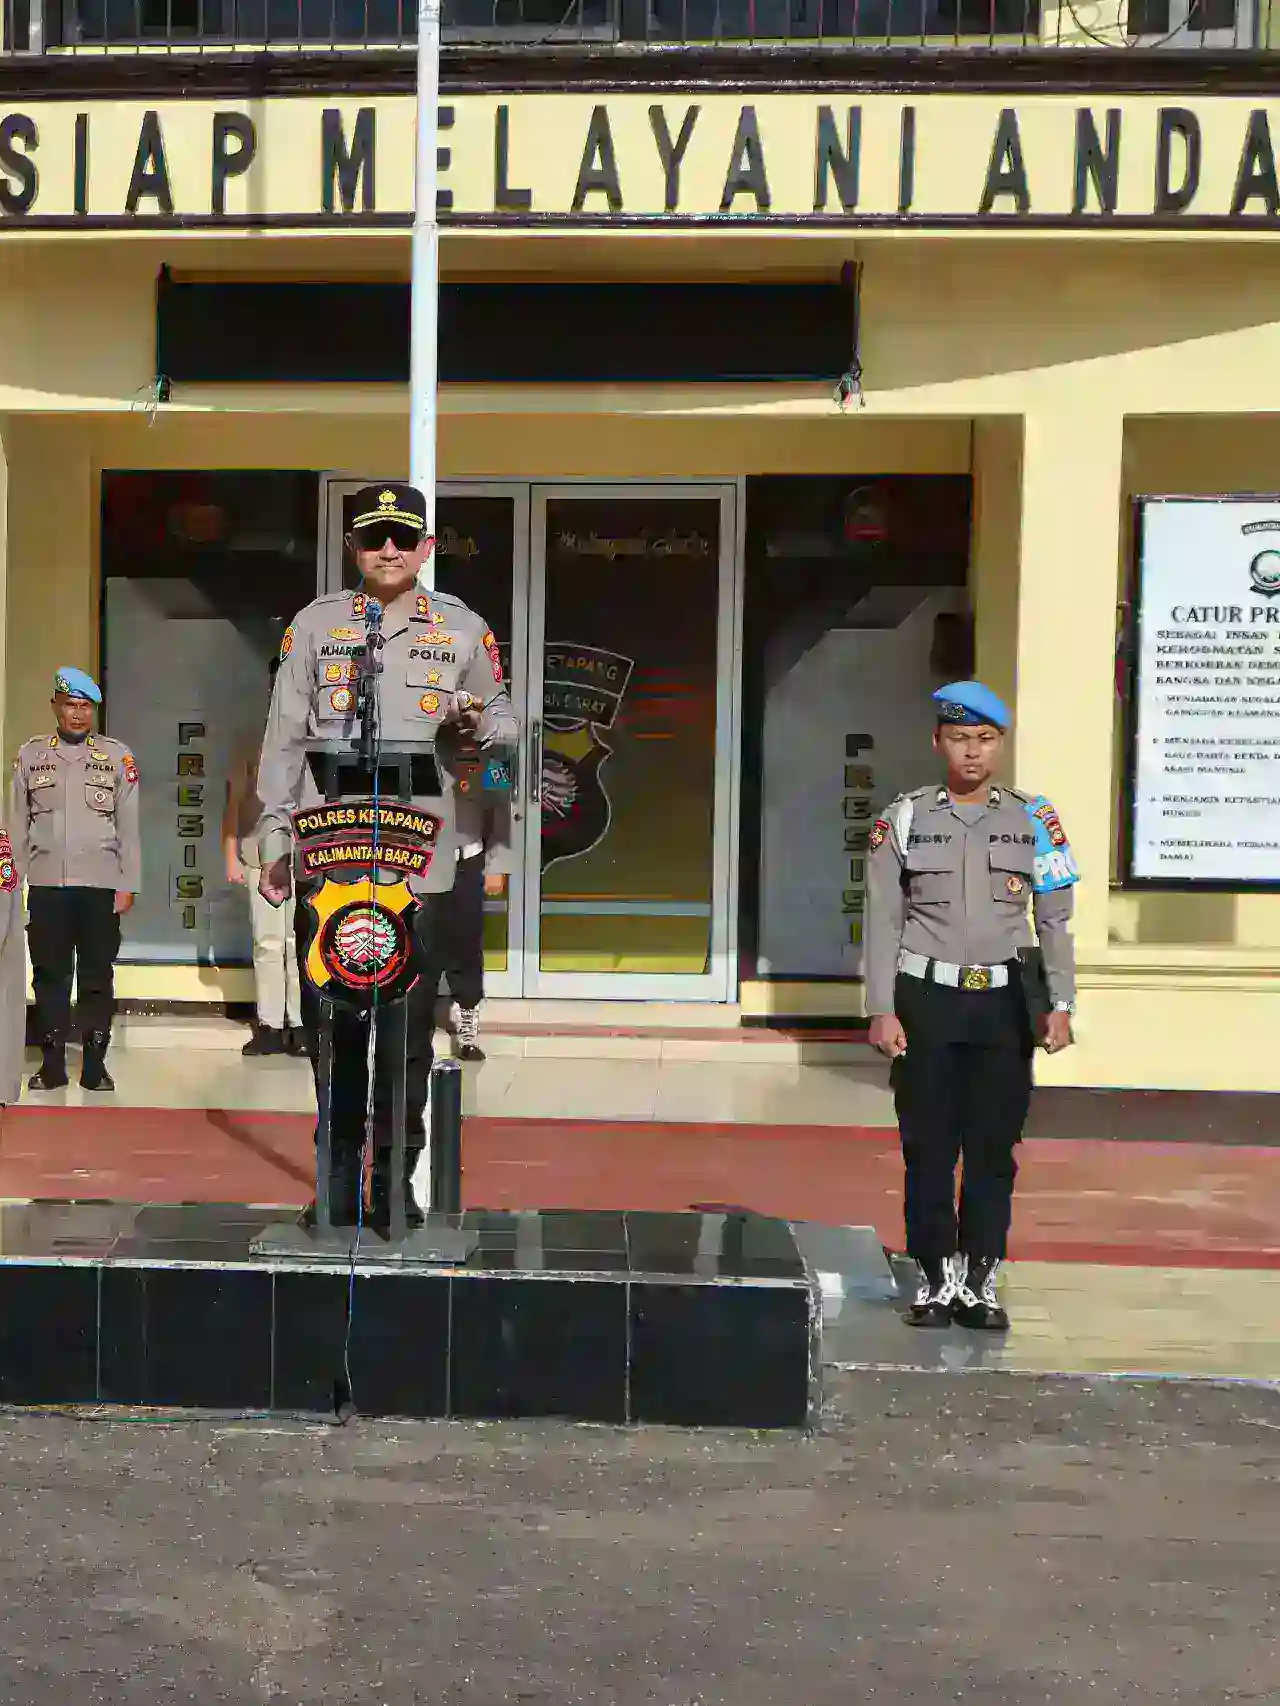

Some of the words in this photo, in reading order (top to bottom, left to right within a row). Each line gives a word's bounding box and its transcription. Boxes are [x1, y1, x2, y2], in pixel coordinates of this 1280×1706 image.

[320, 104, 917, 217] MELAYANI
[978, 107, 1280, 214] ANDA
[1172, 605, 1243, 624] CATUR
[409, 649, 457, 664] POLRI
[85, 763, 115, 772] POLRI
[297, 808, 357, 833] POLRES
[358, 808, 435, 836] KETAPANG
[989, 834, 1038, 846] POLRI
[307, 846, 383, 867] KALIMANTAN
[384, 848, 426, 869] BARAT
